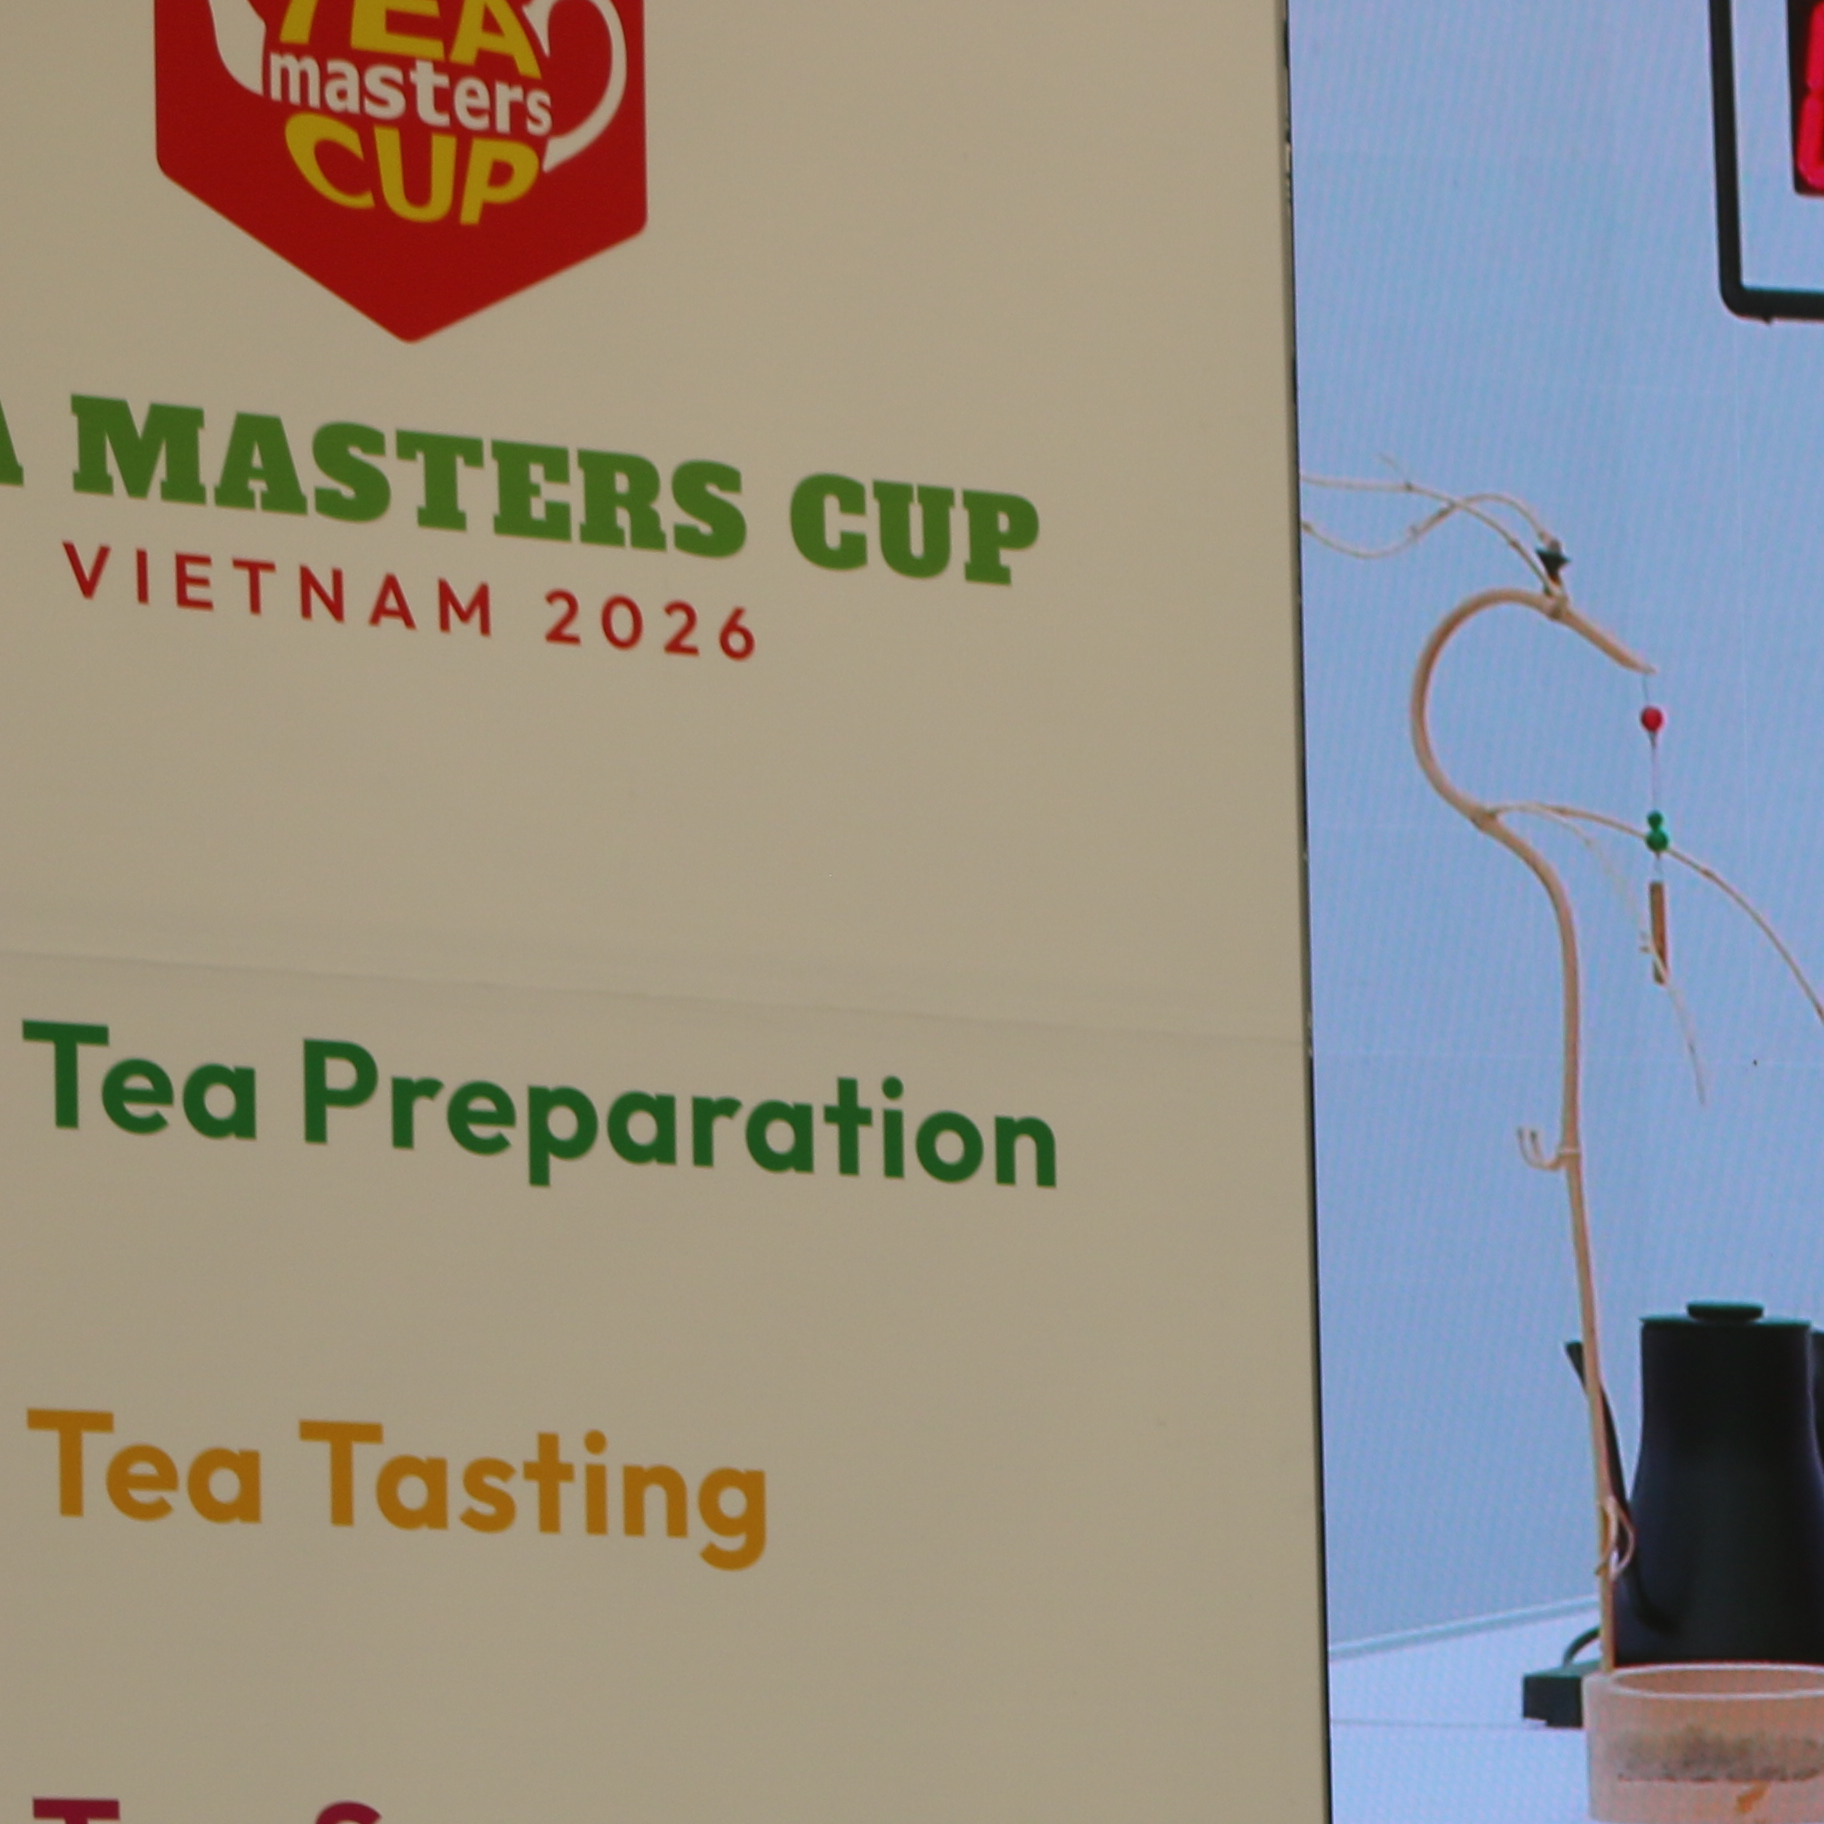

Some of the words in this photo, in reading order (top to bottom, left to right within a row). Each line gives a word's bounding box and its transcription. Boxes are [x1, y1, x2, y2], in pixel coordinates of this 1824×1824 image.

[268, 51, 554, 137] masters
[284, 111, 541, 226] CUP
[69, 393, 748, 559] MASTERS
[790, 474, 1039, 585] CUP
[63, 542, 490, 636] VIETNAM
[546, 590, 754, 660] 2026
[22, 1020, 256, 1140] Tea
[304, 1039, 1056, 1188] Preparation
[27, 1409, 261, 1523] Tea
[299, 1420, 766, 1571] Tasting
